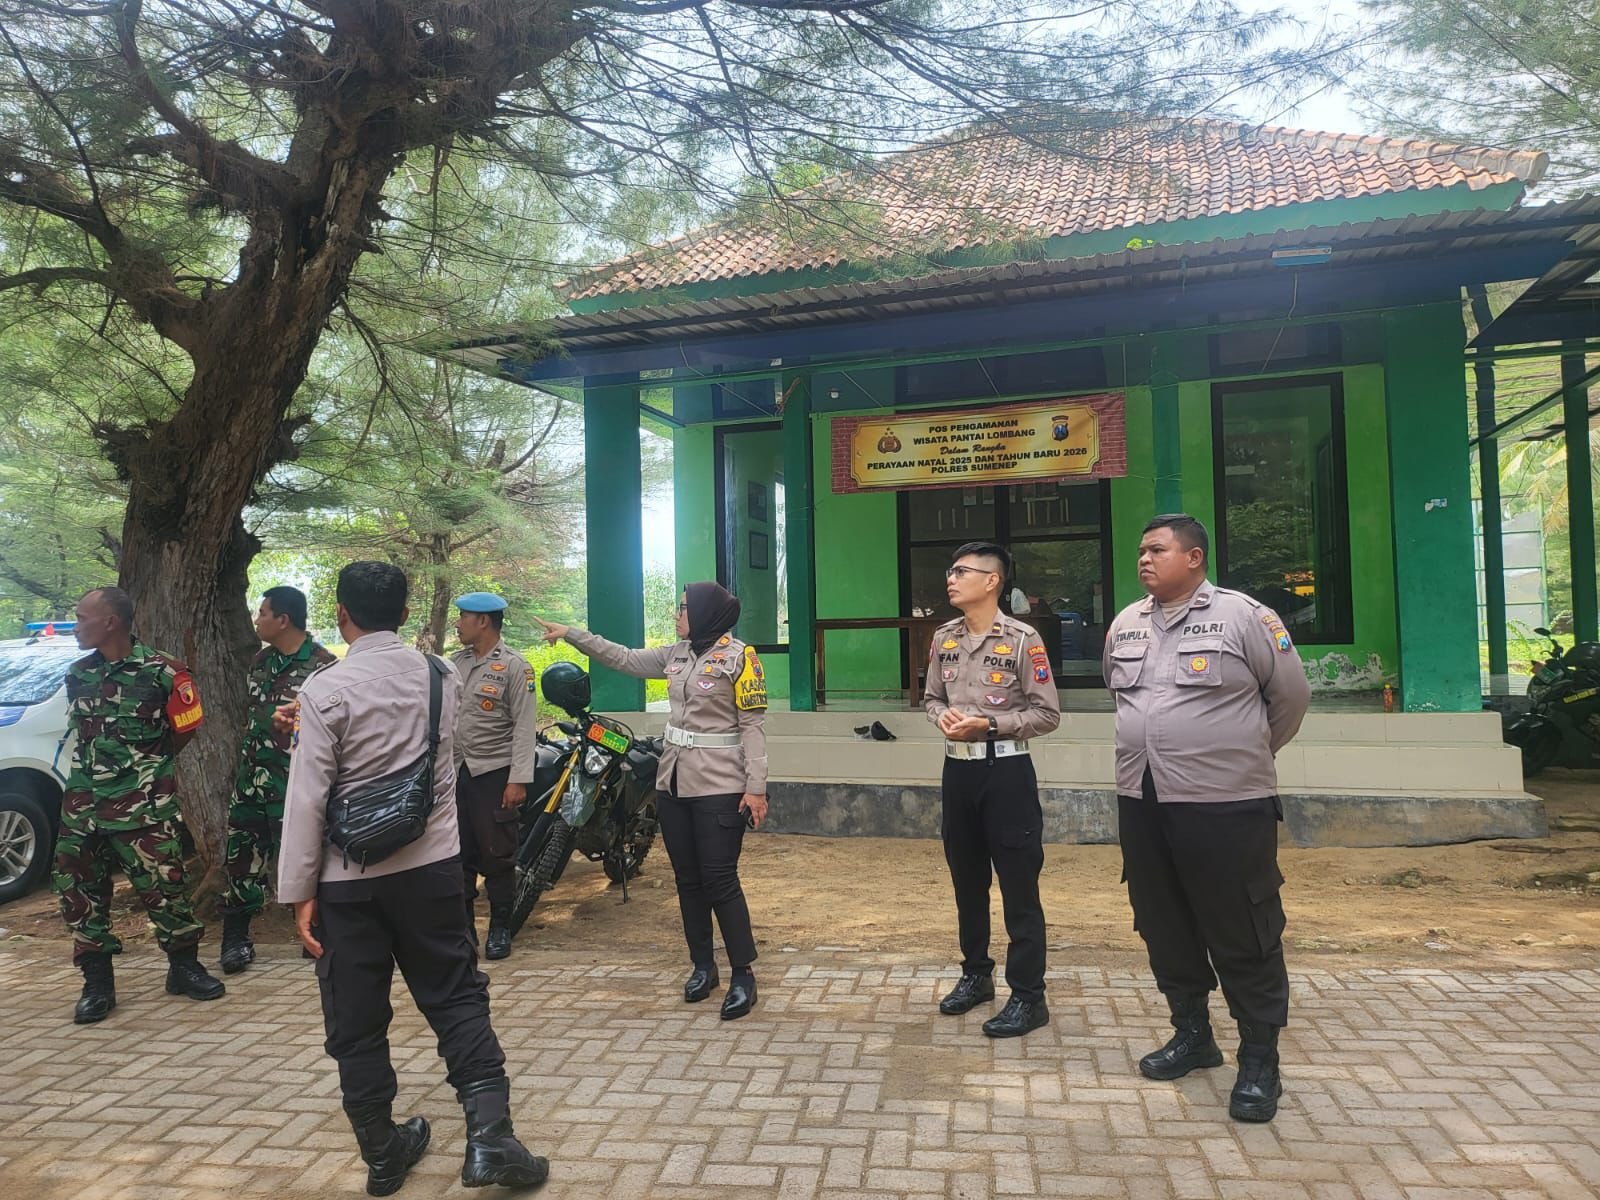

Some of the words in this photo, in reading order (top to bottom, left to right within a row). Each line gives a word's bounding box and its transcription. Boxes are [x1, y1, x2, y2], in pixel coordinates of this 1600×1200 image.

[929, 426, 948, 434] POS
[950, 420, 1018, 431] PENGAMANAN
[913, 435, 949, 445] WISATA
[950, 432, 985, 442] PANTAI
[987, 429, 1036, 439] LOMBANG
[939, 446, 969, 455] Dalam
[972, 443, 1006, 454] Rangka
[867, 460, 916, 470] PERAYAAN
[917, 458, 947, 467] NATAL
[950, 456, 972, 465] 2025
[974, 454, 995, 463] DAN
[997, 452, 1031, 462] TAHUN
[1033, 449, 1061, 459] BARU
[1063, 447, 1088, 457] 2026
[931, 464, 969, 474] POLRES
[971, 461, 1018, 472] SUMENEP
[1183, 623, 1224, 635] POLRI
[703, 658, 728, 666] POLRI
[983, 655, 1017, 670] POLRI
[482, 673, 504, 681] POLRI
